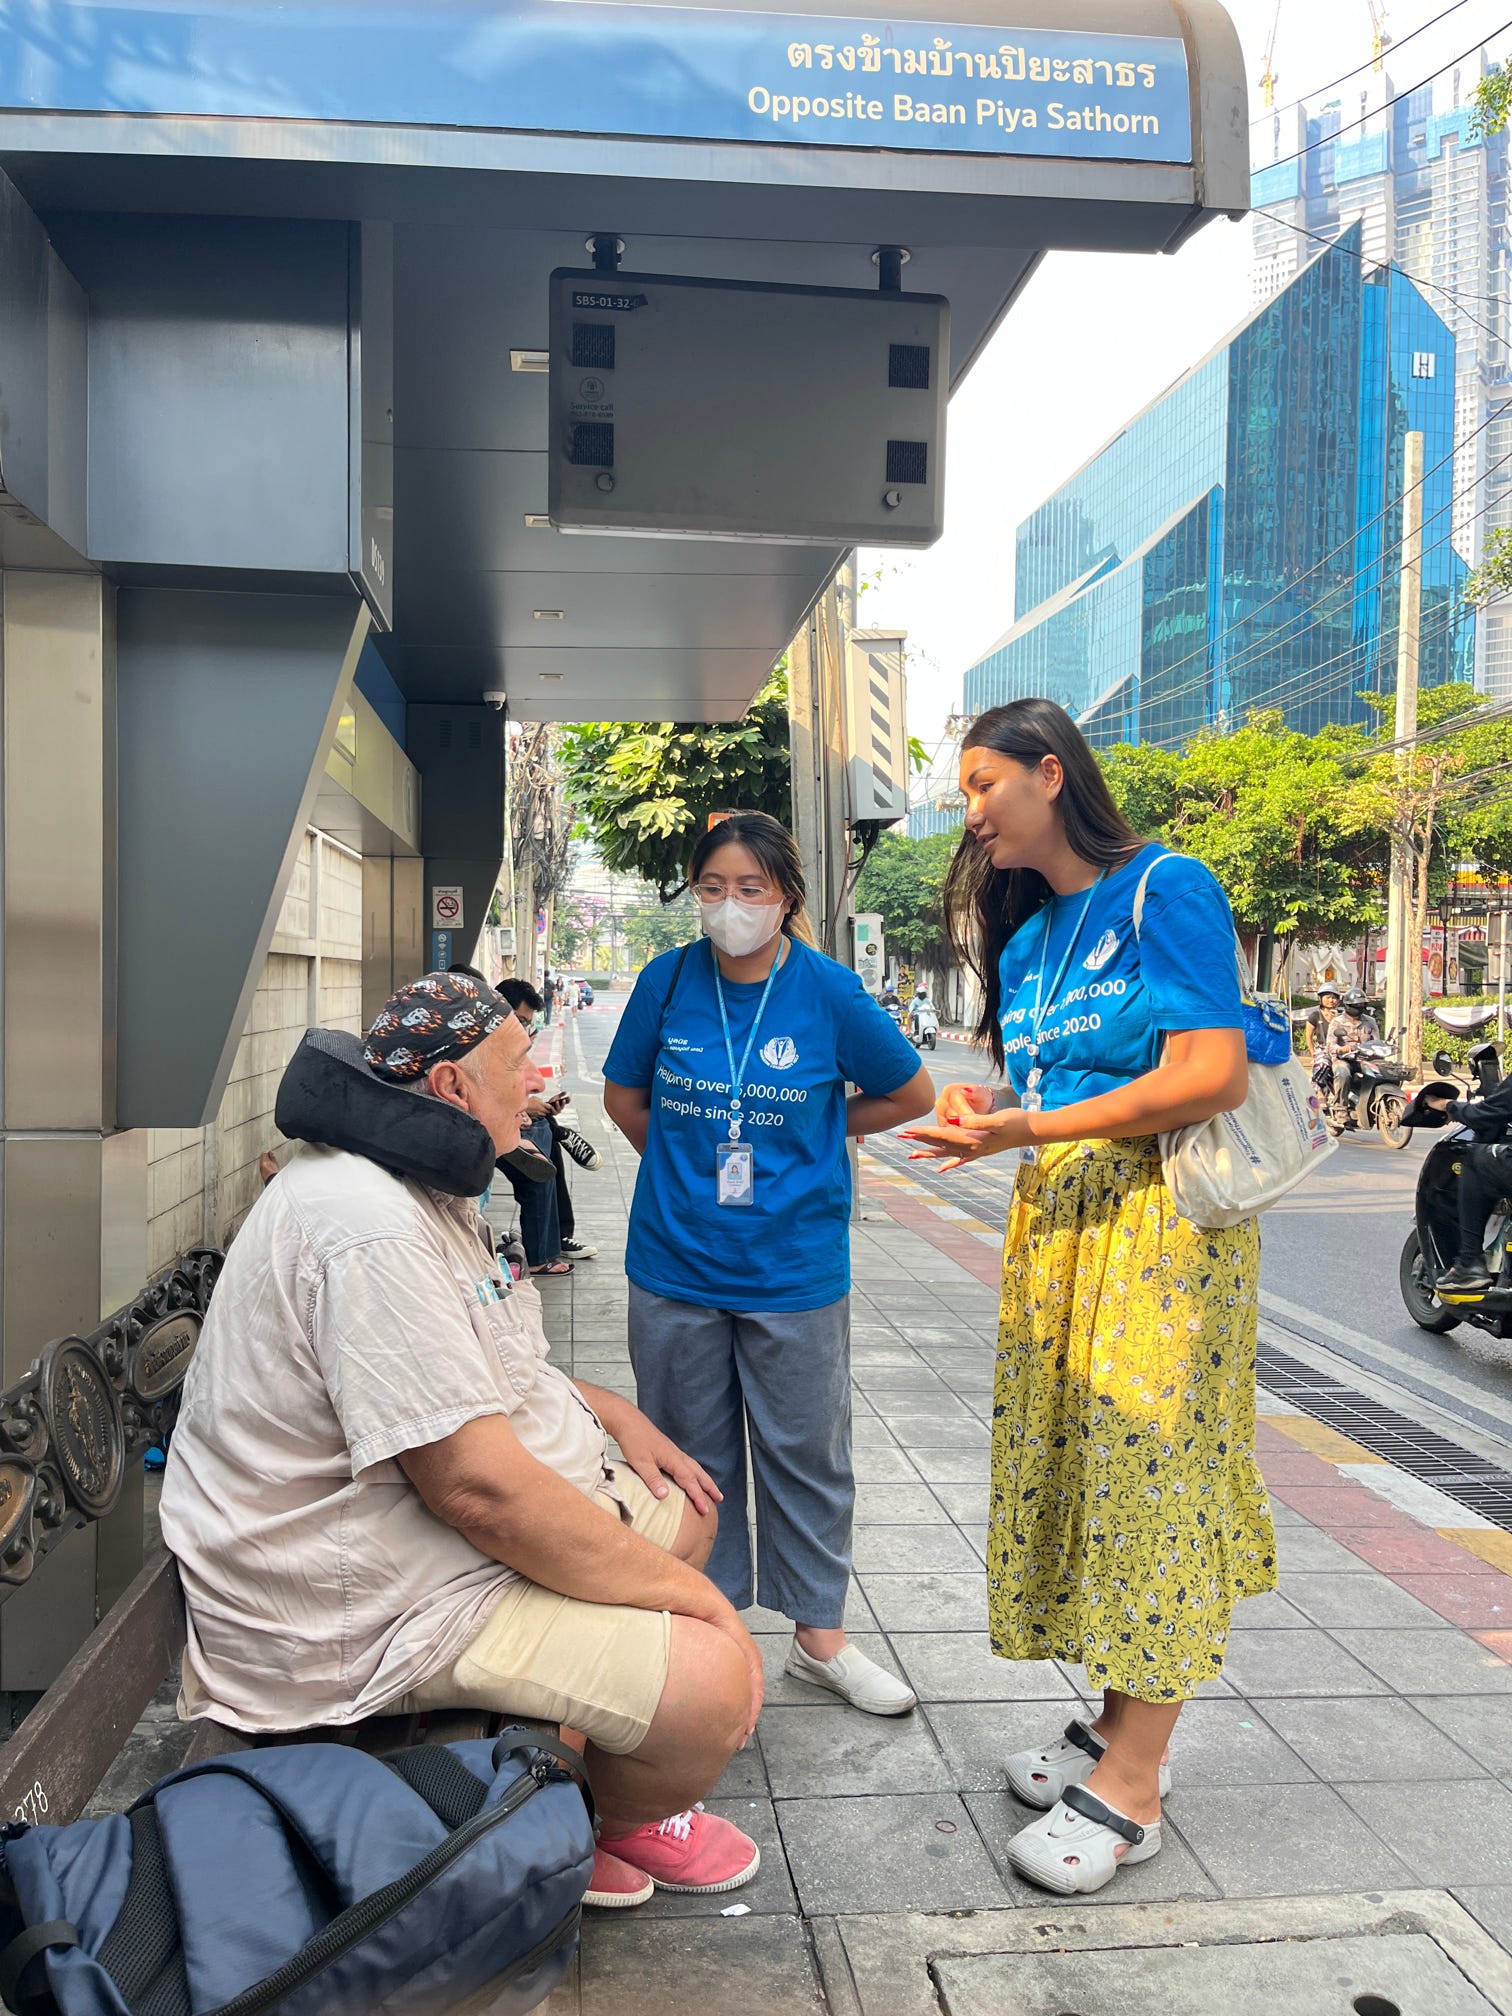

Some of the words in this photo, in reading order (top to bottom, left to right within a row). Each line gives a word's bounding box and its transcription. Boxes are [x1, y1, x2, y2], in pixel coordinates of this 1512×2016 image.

[788, 33, 1156, 88] ตรงข้ามบ้านปิยะสาธร
[748, 86, 884, 122] Opposite
[894, 94, 966, 125] Baan
[976, 98, 1038, 133] Piya
[1047, 103, 1160, 134] Sathorn
[1062, 1013, 1102, 1037] 2020
[656, 1065, 693, 1092] Helping
[696, 1079, 732, 1094] over
[661, 1096, 702, 1116] people
[748, 1110, 784, 1127] 2020
